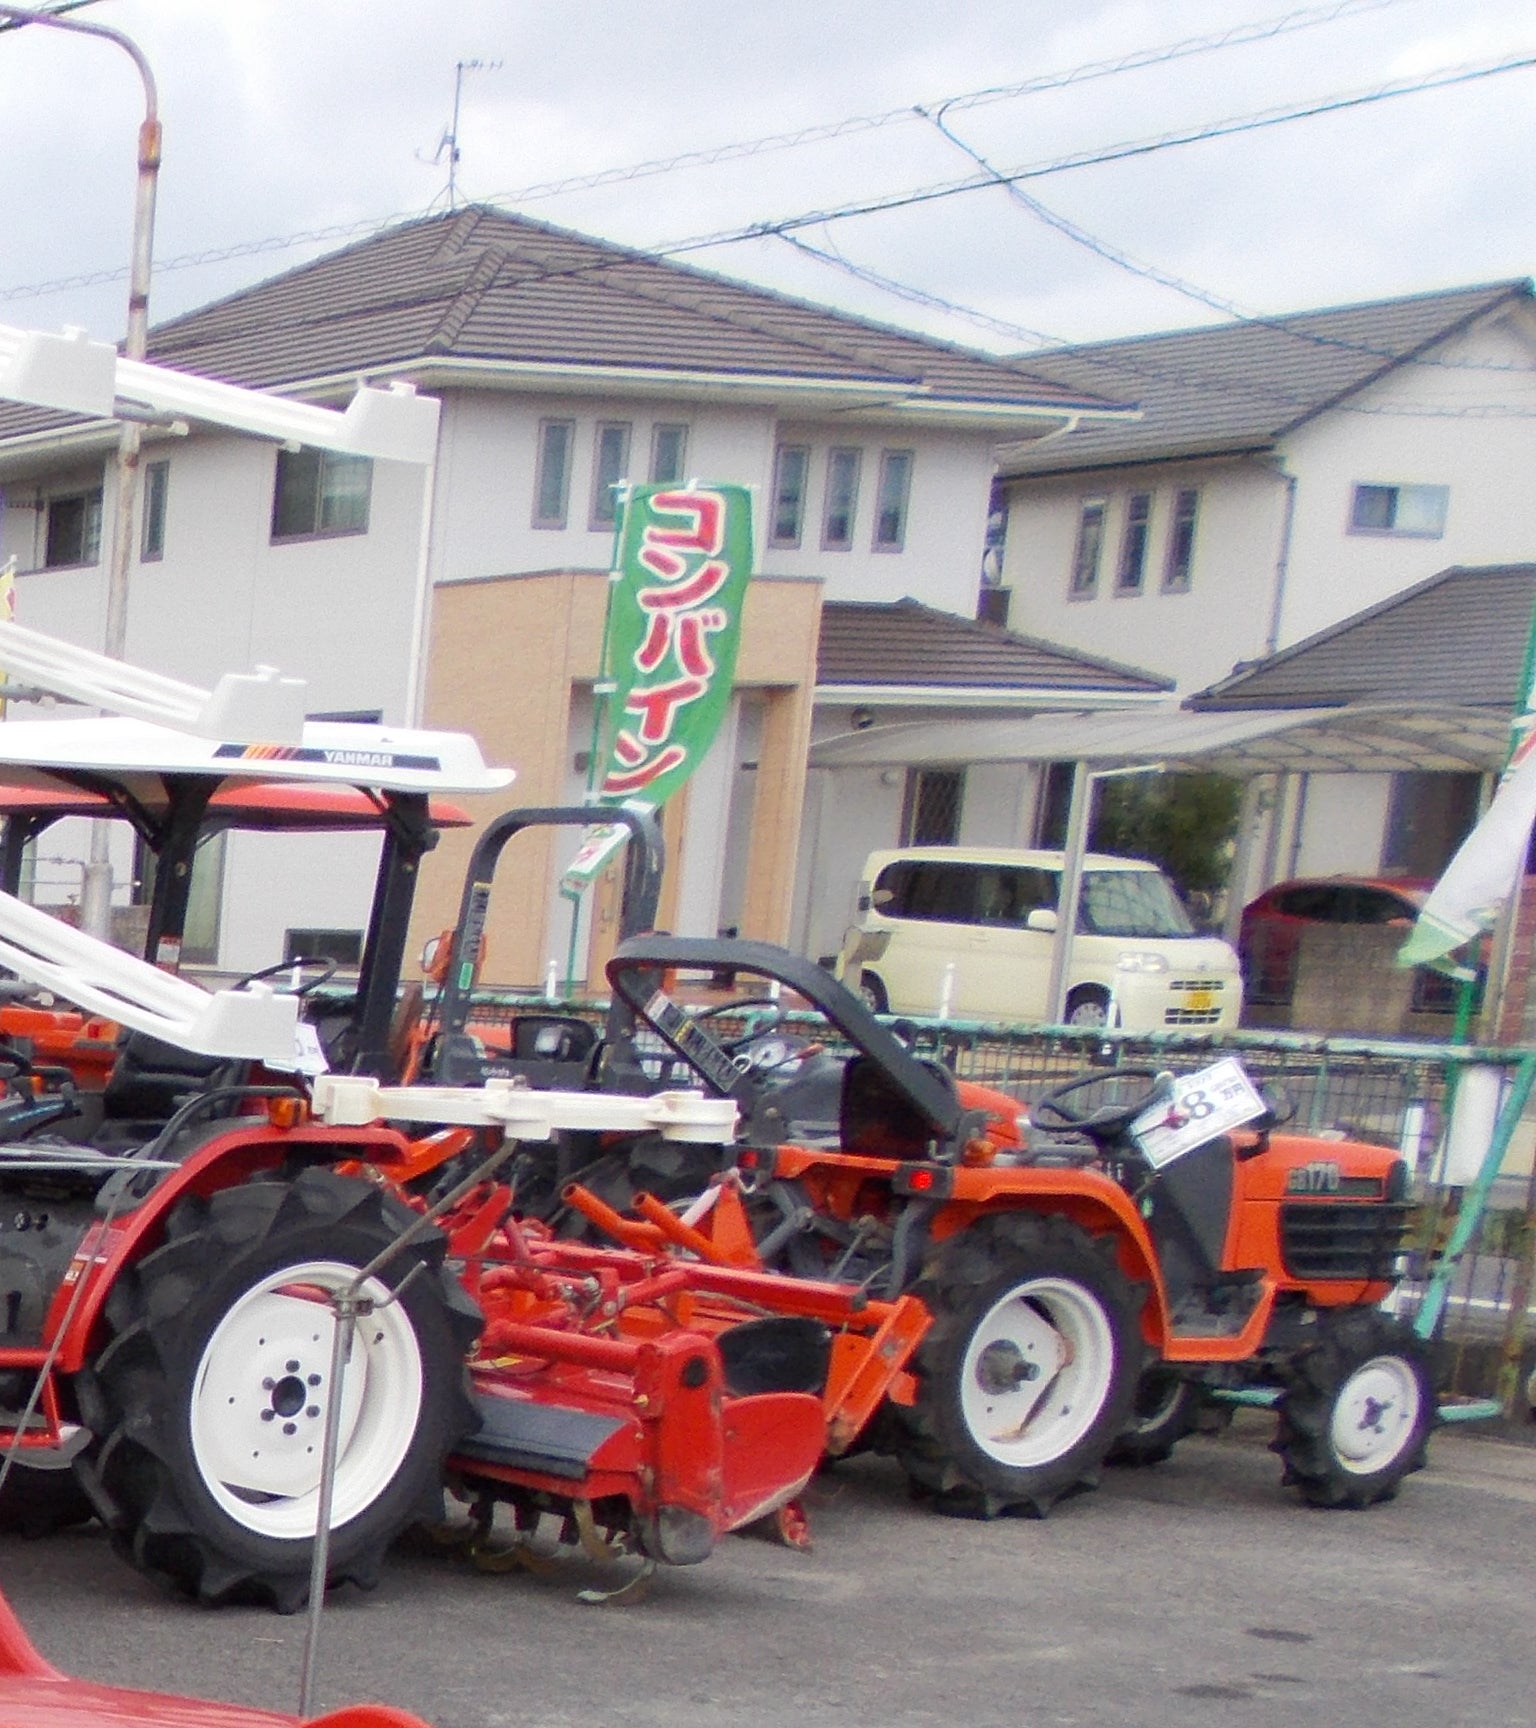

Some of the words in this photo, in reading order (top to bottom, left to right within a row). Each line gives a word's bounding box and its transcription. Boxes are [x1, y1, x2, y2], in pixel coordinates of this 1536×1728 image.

[602, 490, 729, 796] コンバイン
[324, 751, 393, 768] YANMAR
